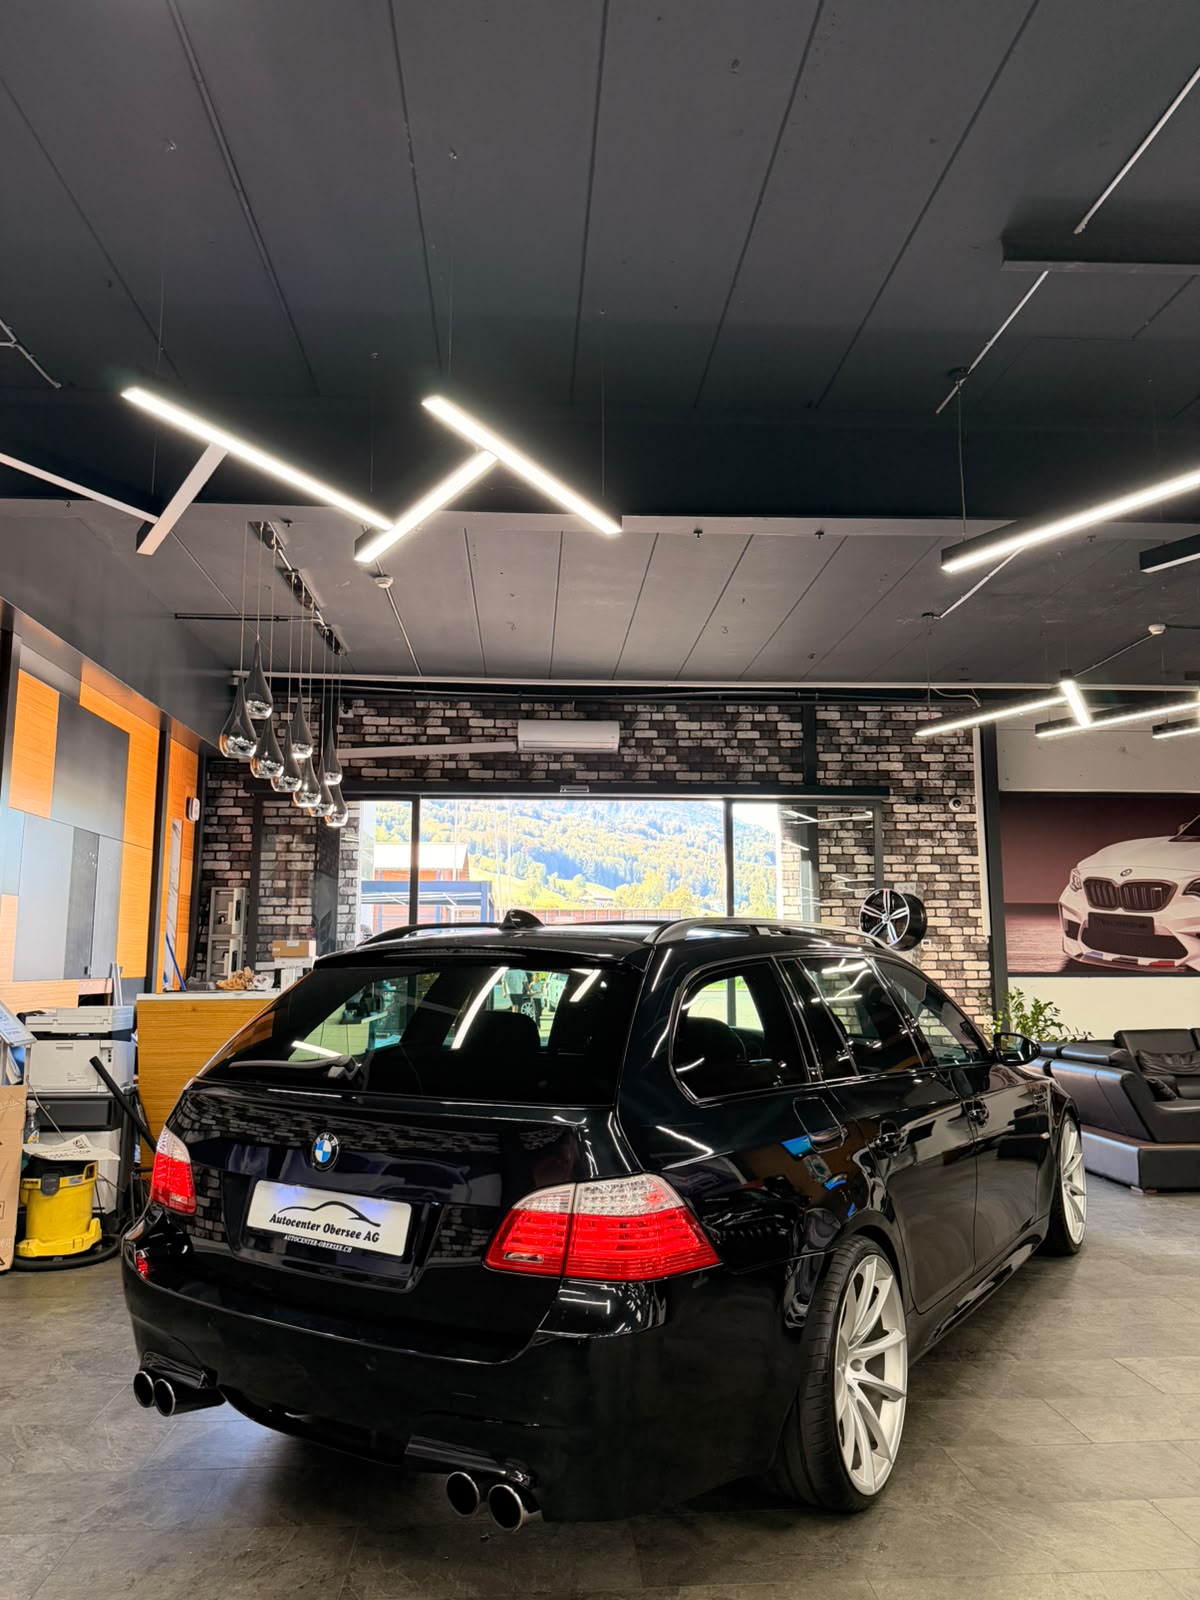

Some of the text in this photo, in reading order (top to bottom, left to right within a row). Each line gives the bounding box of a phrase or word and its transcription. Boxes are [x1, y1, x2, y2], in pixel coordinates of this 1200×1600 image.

[269, 1213, 380, 1243] Autocenter Obersee AG
[284, 1235, 352, 1253] AUTOCENTER-OBERSEE.CH
